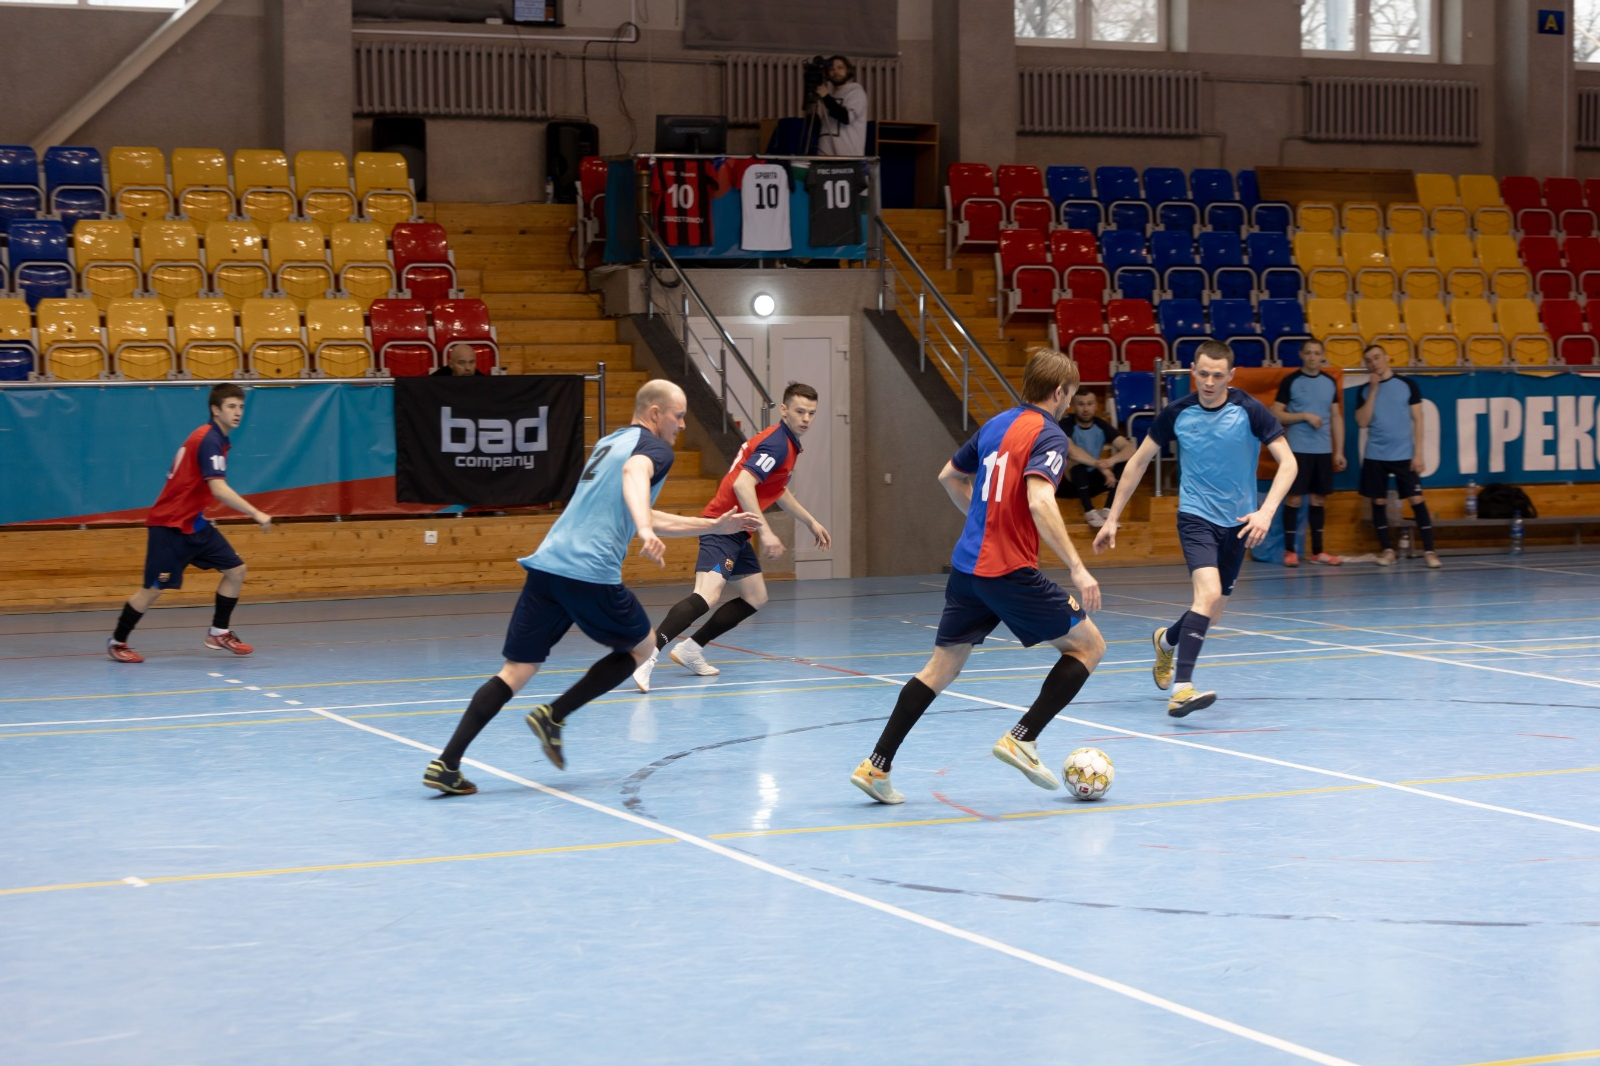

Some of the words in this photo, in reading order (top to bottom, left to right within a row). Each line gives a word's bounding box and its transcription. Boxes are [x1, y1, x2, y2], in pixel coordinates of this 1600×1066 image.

[1544, 14, 1558, 31] A
[667, 183, 695, 210] 10
[755, 183, 779, 210] 10
[823, 180, 851, 210] 10
[441, 405, 549, 454] bad
[1456, 395, 1600, 475] ГРЕК
[455, 455, 535, 472] company
[579, 445, 614, 483] 2
[755, 453, 776, 473] 10
[981, 450, 1010, 502] 11
[1043, 450, 1064, 476] 10
